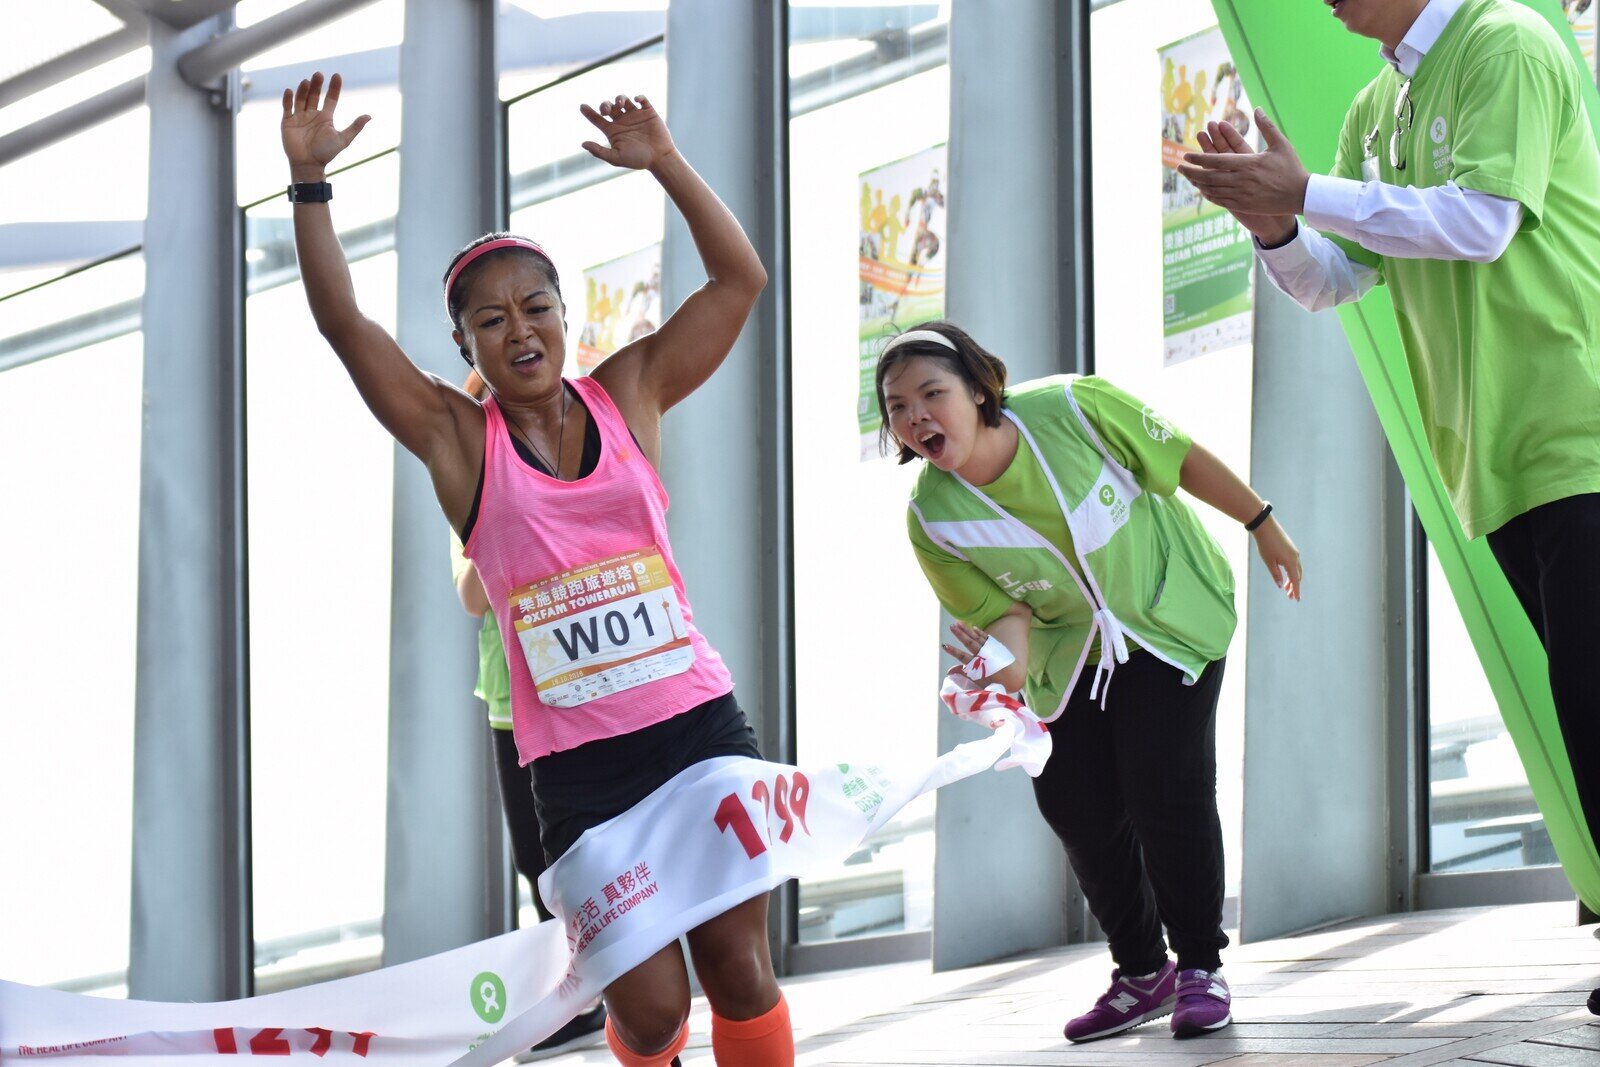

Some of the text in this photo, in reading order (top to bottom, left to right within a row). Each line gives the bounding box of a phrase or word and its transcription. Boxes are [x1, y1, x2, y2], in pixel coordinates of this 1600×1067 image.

[519, 565, 632, 613] 樂施競跑旅遊塔
[523, 582, 636, 624] OXFAM TOWERRUN
[553, 602, 655, 662] W01
[601, 861, 651, 906] 真夥伴
[583, 923, 602, 944] REAL
[599, 908, 619, 928] LIFE
[617, 881, 659, 915] COMPANY
